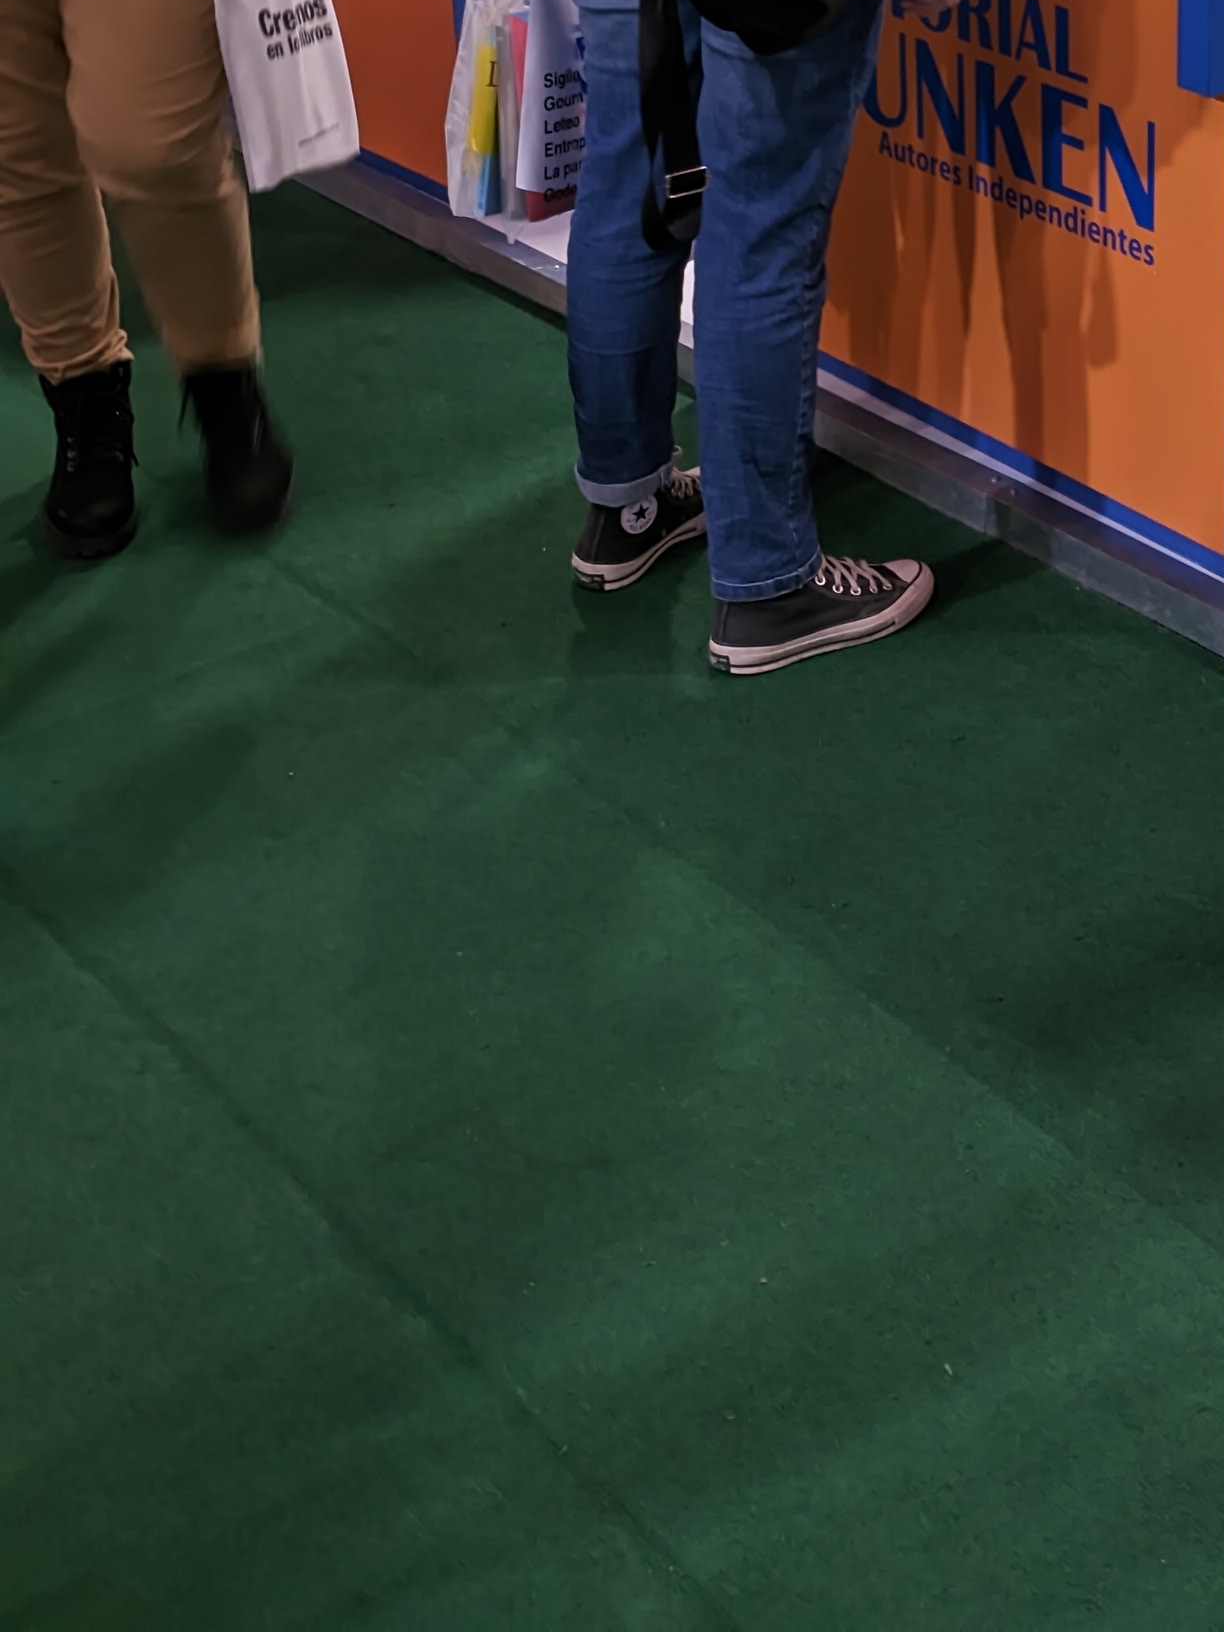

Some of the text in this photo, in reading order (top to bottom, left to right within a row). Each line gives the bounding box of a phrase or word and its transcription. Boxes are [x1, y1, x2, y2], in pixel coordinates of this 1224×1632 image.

[267, 41, 284, 61] en
[544, 165, 560, 180] La
[878, 130, 1155, 267] Autores Independientes
